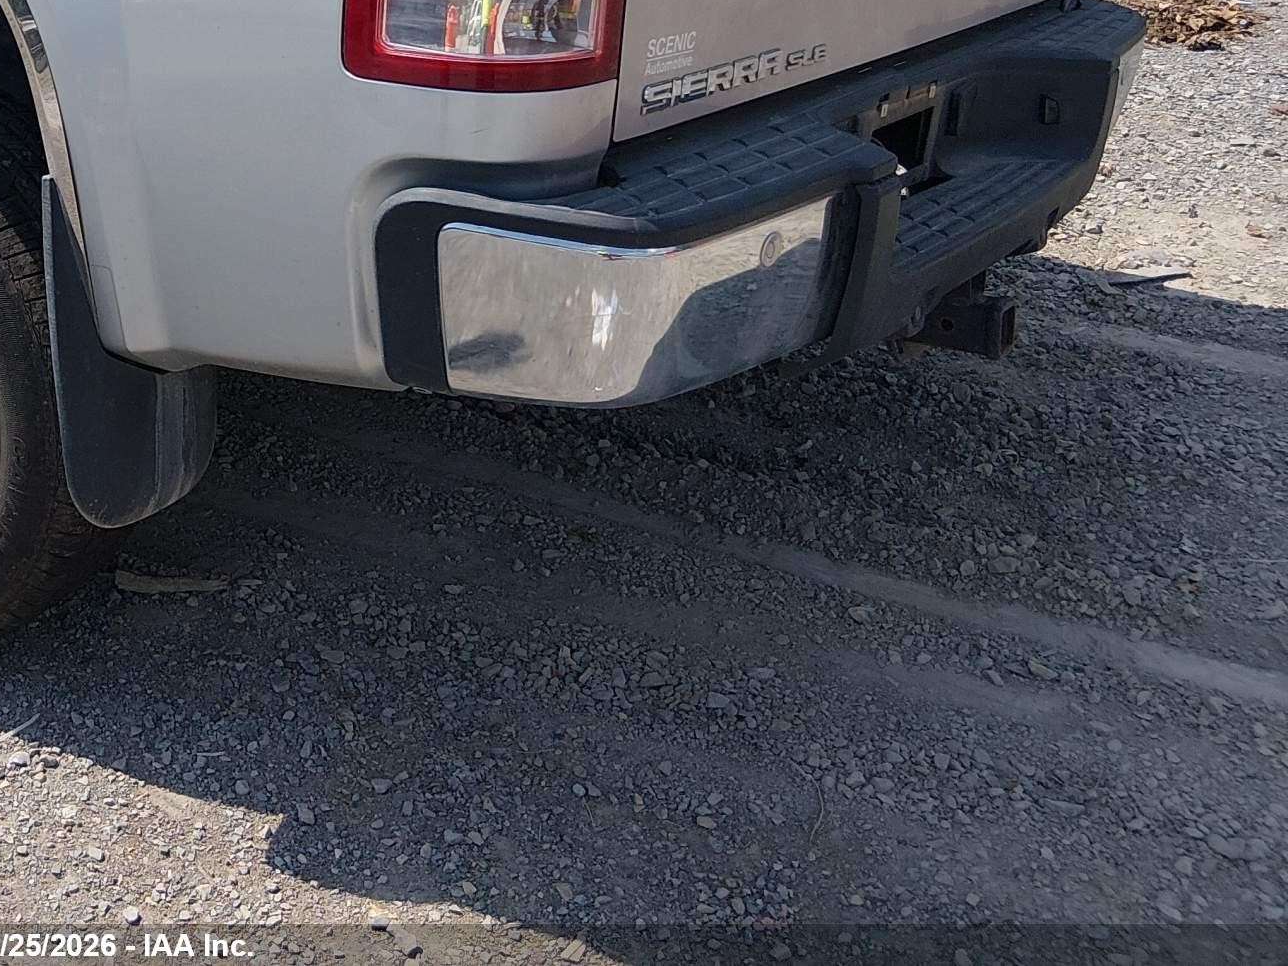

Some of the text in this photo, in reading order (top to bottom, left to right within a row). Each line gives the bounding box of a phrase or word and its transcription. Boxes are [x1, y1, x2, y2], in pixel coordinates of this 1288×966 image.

[646, 31, 696, 59] SCENIC
[644, 54, 694, 77] Automotive
[640, 47, 783, 116] SIERRA
